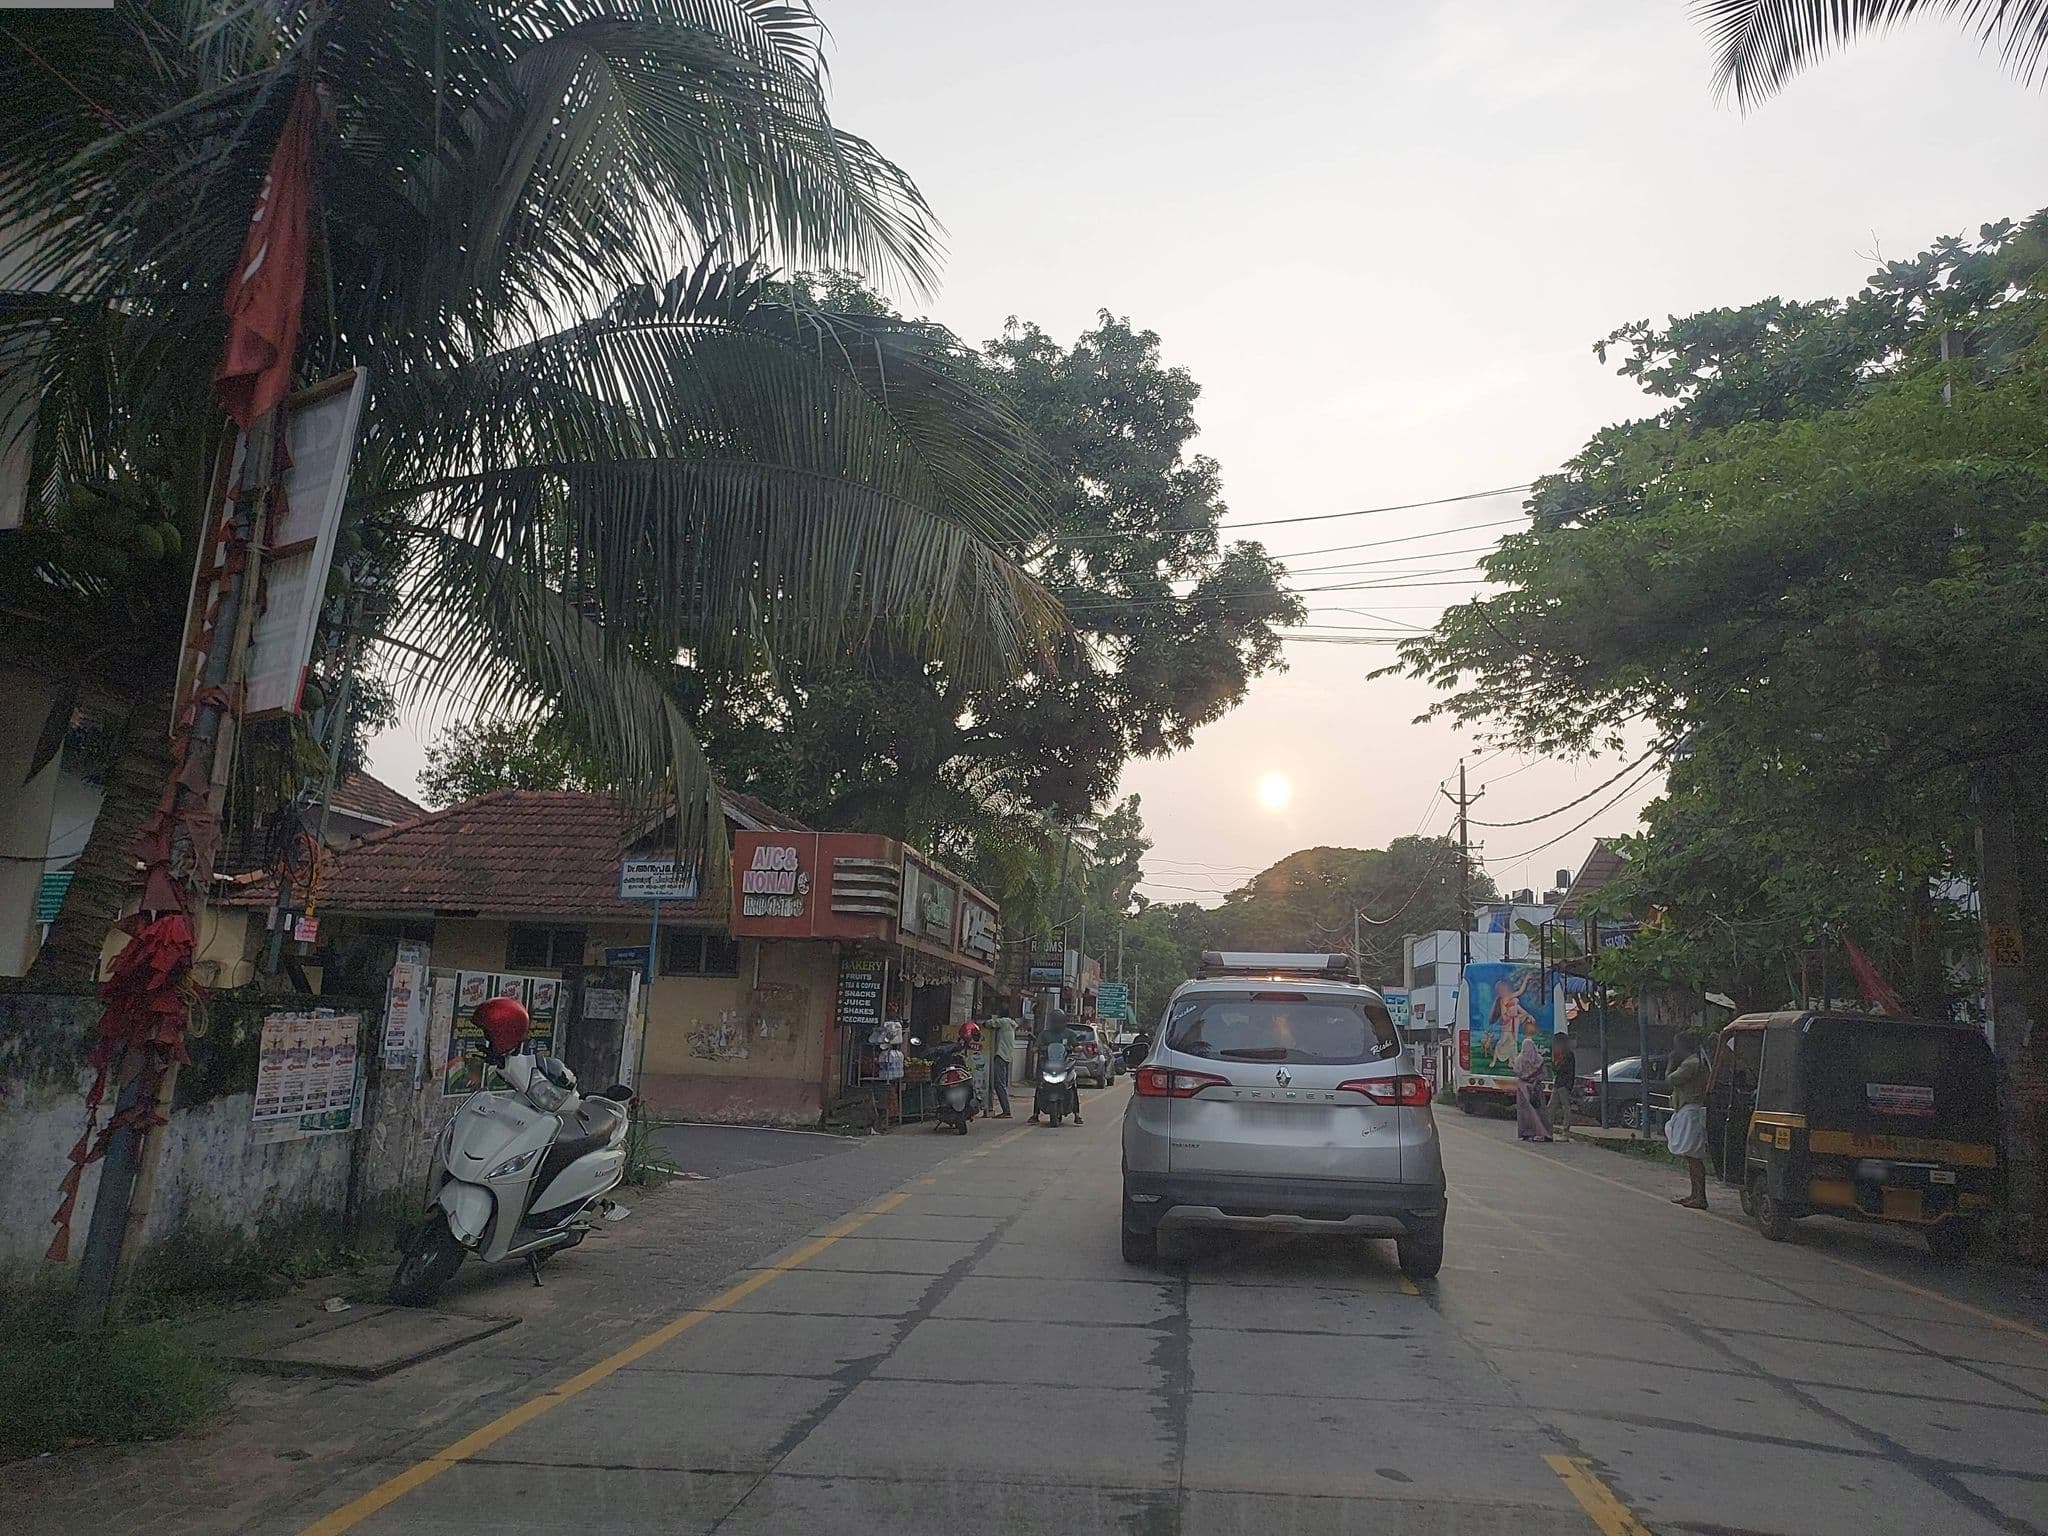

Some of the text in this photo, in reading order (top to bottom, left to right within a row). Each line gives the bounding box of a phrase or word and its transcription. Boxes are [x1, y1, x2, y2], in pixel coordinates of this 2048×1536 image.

[841, 960, 882, 971] BAKERY
[845, 973, 872, 981] FRUITS
[860, 982, 881, 990] COFFEE
[844, 990, 876, 998] SNACKS
[843, 1007, 875, 1015] SHAKES
[842, 1016, 879, 1024] ICECREAMS
[1232, 1090, 1335, 1100] TRIBER
